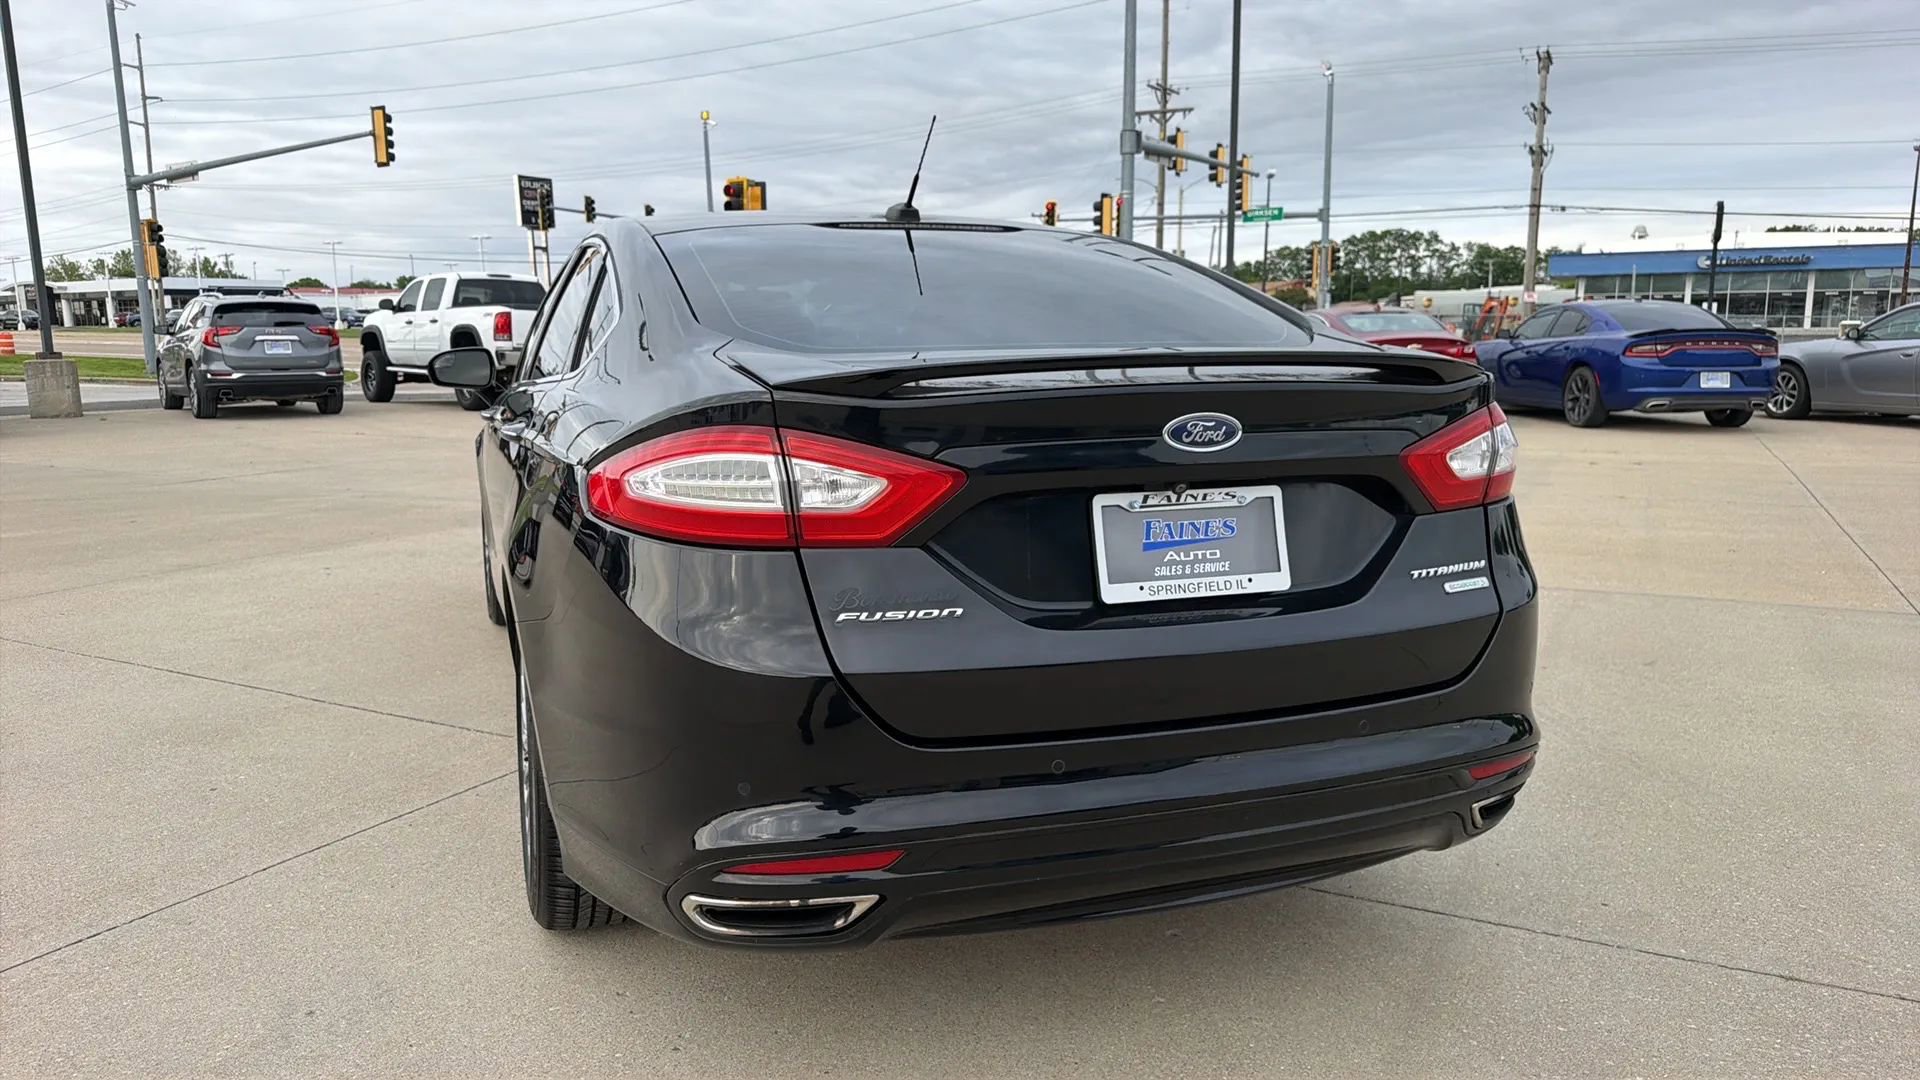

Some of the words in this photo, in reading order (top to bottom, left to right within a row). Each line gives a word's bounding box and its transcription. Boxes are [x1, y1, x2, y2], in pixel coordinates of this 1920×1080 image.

[1182, 421, 1226, 442] Ford
[1141, 491, 1237, 505] FAINE'S
[1164, 549, 1220, 562] AUTO
[1154, 564, 1182, 576] SALES
[1185, 564, 1191, 574] &
[1194, 561, 1230, 573] SERVICE
[1410, 560, 1486, 580] TITANIUM
[1148, 580, 1232, 596] SPRINGFIELD
[1236, 579, 1247, 590] IL
[836, 608, 963, 623] FUSION
